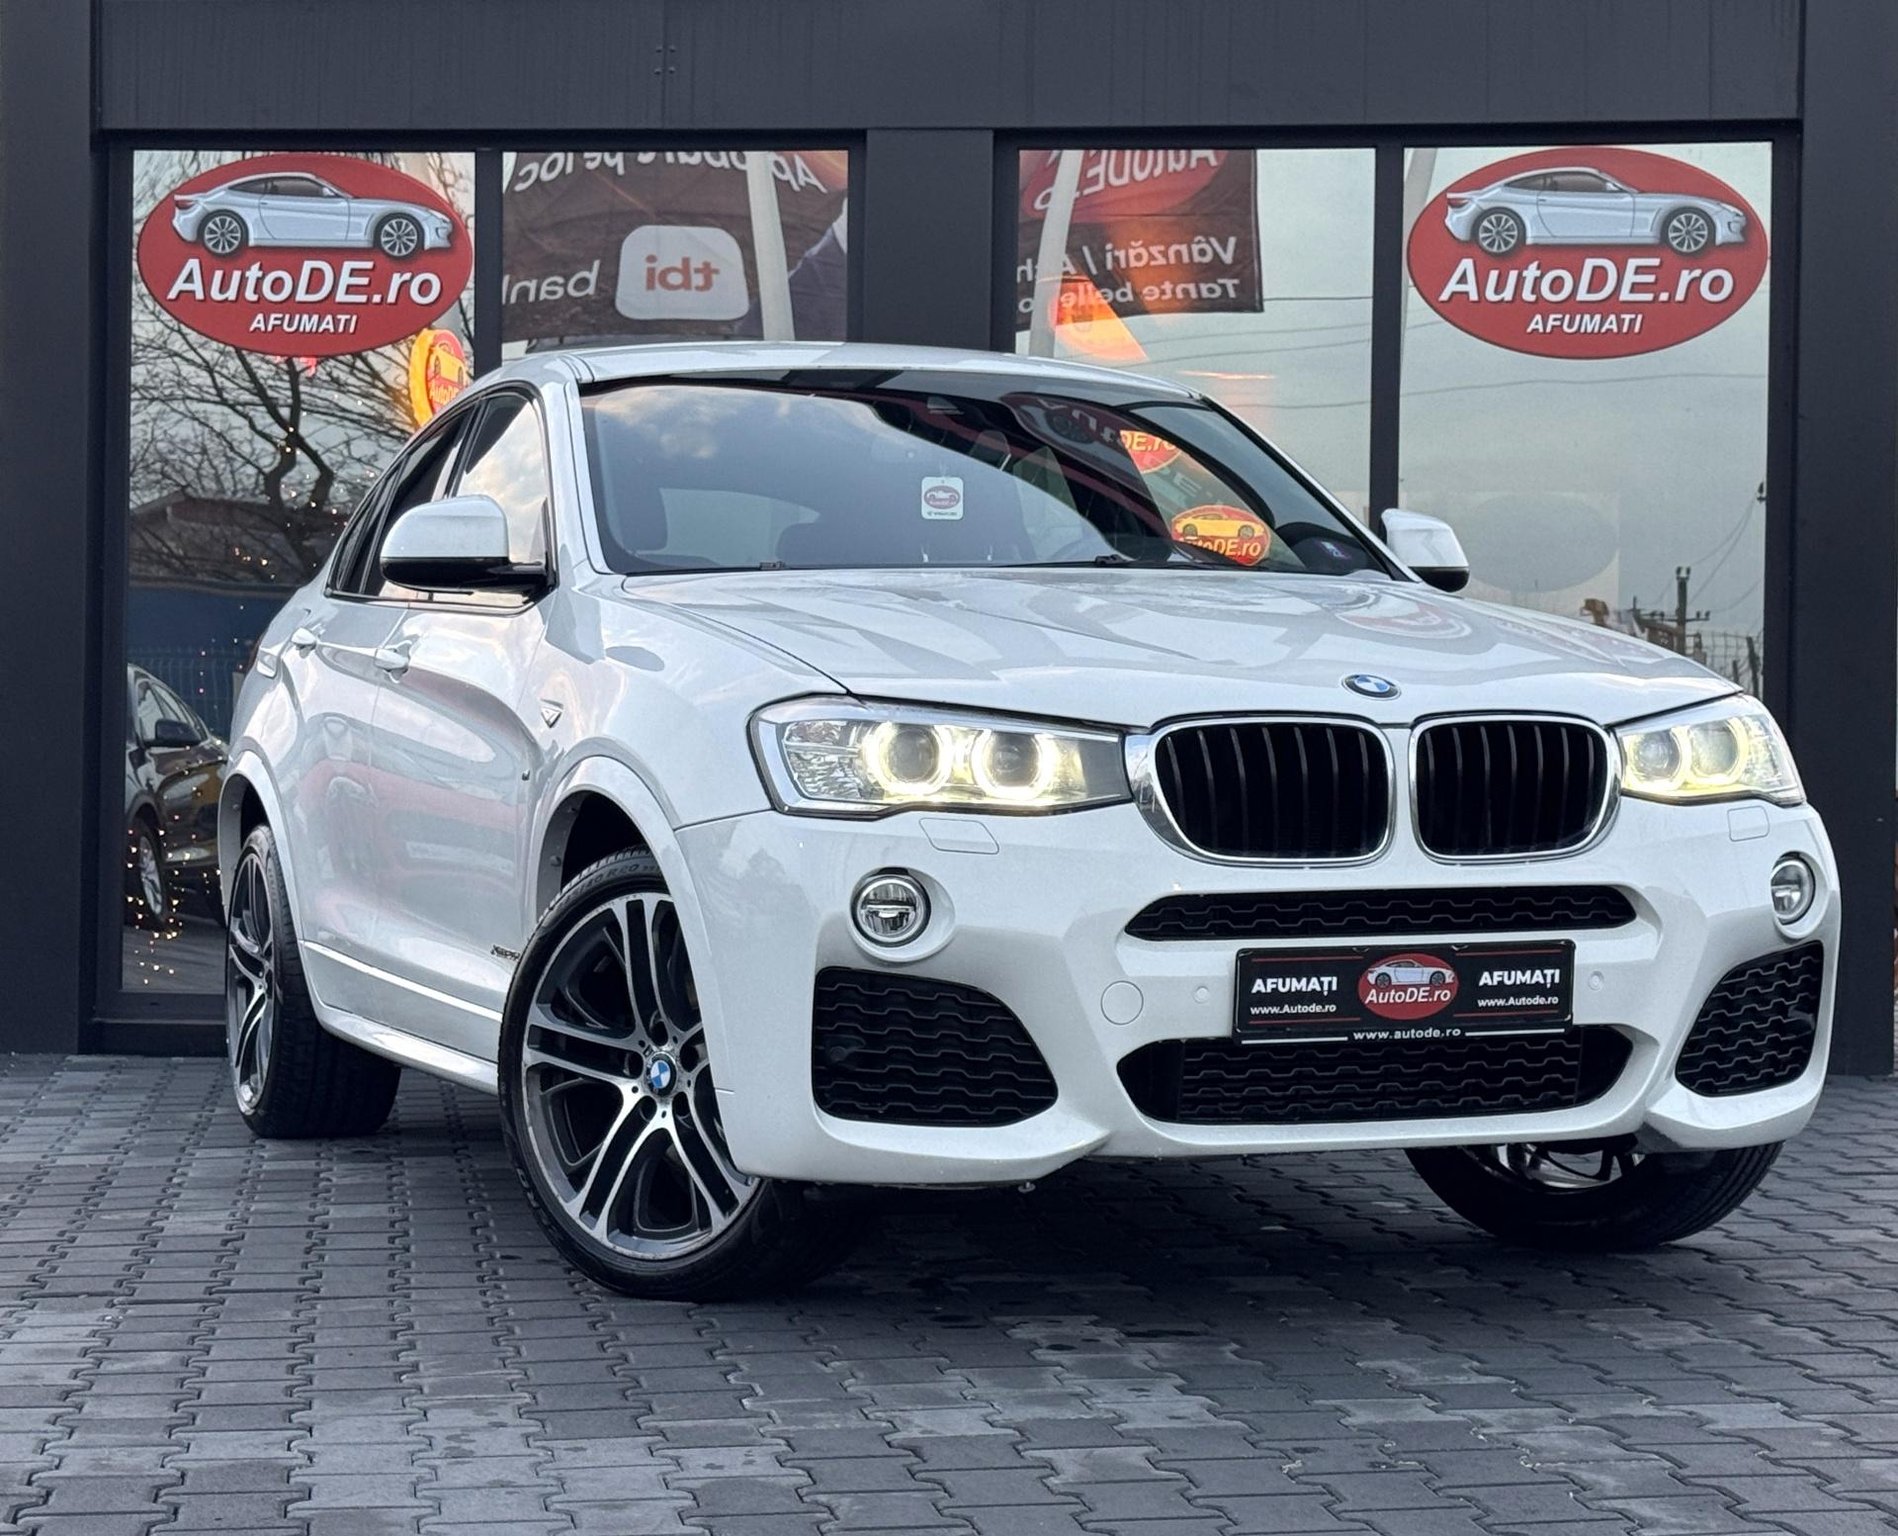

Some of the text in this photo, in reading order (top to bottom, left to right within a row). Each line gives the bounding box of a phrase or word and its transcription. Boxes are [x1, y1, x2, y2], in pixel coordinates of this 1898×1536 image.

[167, 258, 441, 305] AutoDE.ro
[1438, 257, 1734, 303] AutoDE.ro
[250, 313, 357, 334] AFUMATI
[1526, 313, 1643, 334] AFUMATI
[1250, 995, 1559, 1016] www.Autode.ro www.Autode.ro
[1365, 986, 1451, 1005] AutoDE.ro
[1353, 1026, 1461, 1041] www.autode.ro
